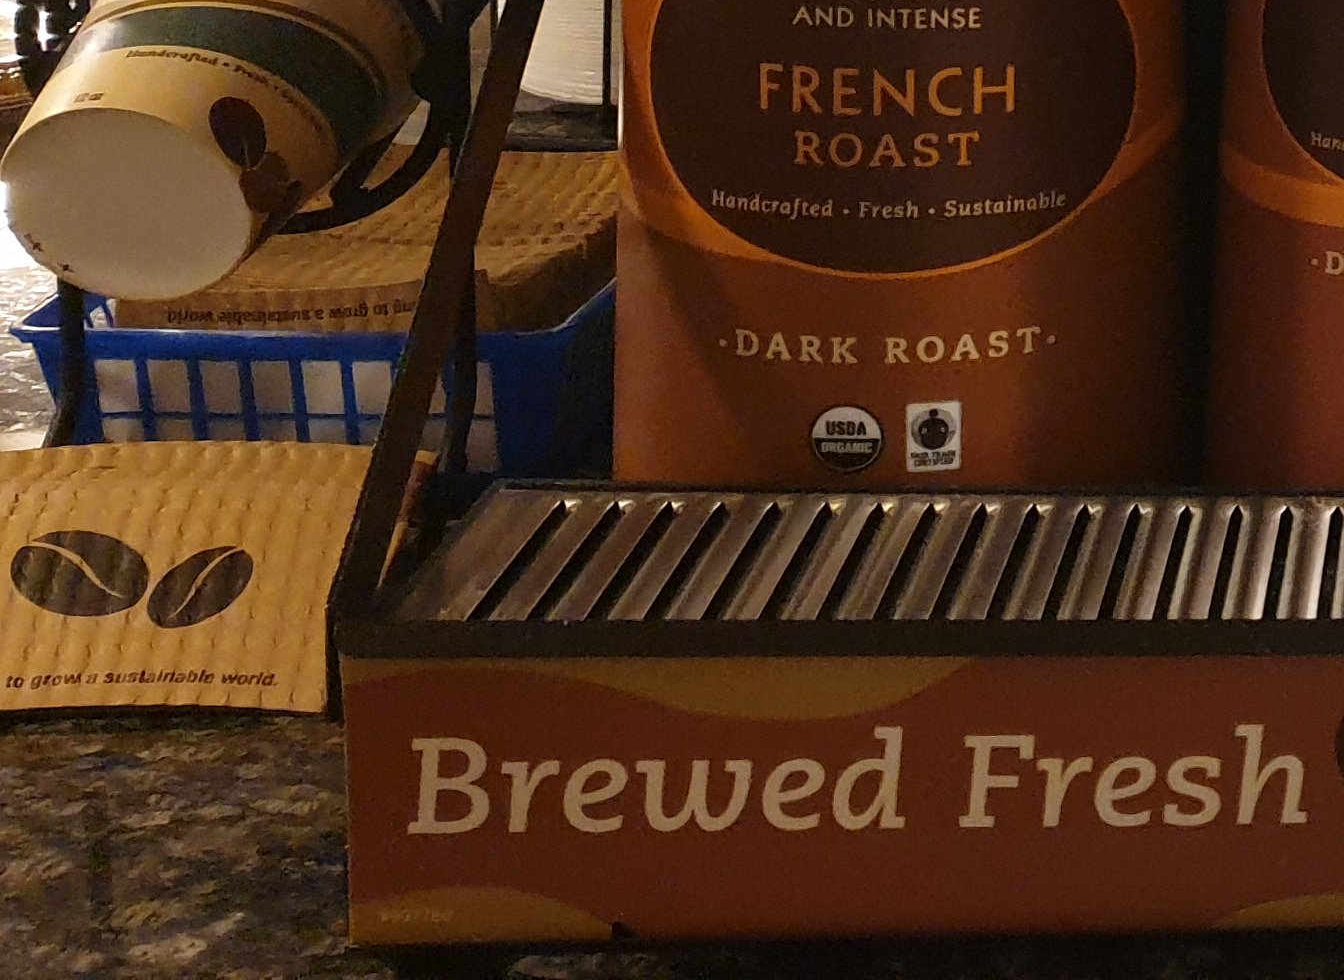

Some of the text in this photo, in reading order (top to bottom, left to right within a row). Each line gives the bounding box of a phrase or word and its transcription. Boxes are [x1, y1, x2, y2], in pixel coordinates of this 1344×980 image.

[792, 5, 983, 30] AND INTENSE
[758, 61, 1017, 118] FRENCH
[792, 129, 981, 169] ROAST
[711, 188, 1067, 221] Handcrafted Fresh Sustainable
[735, 326, 1042, 365] DARK ROAST
[825, 420, 867, 436] USDA
[5, 674, 25, 689] to
[31, 672, 82, 691] grow
[102, 668, 216, 685] sustainable
[407, 723, 1308, 835] Brewed Fresh
